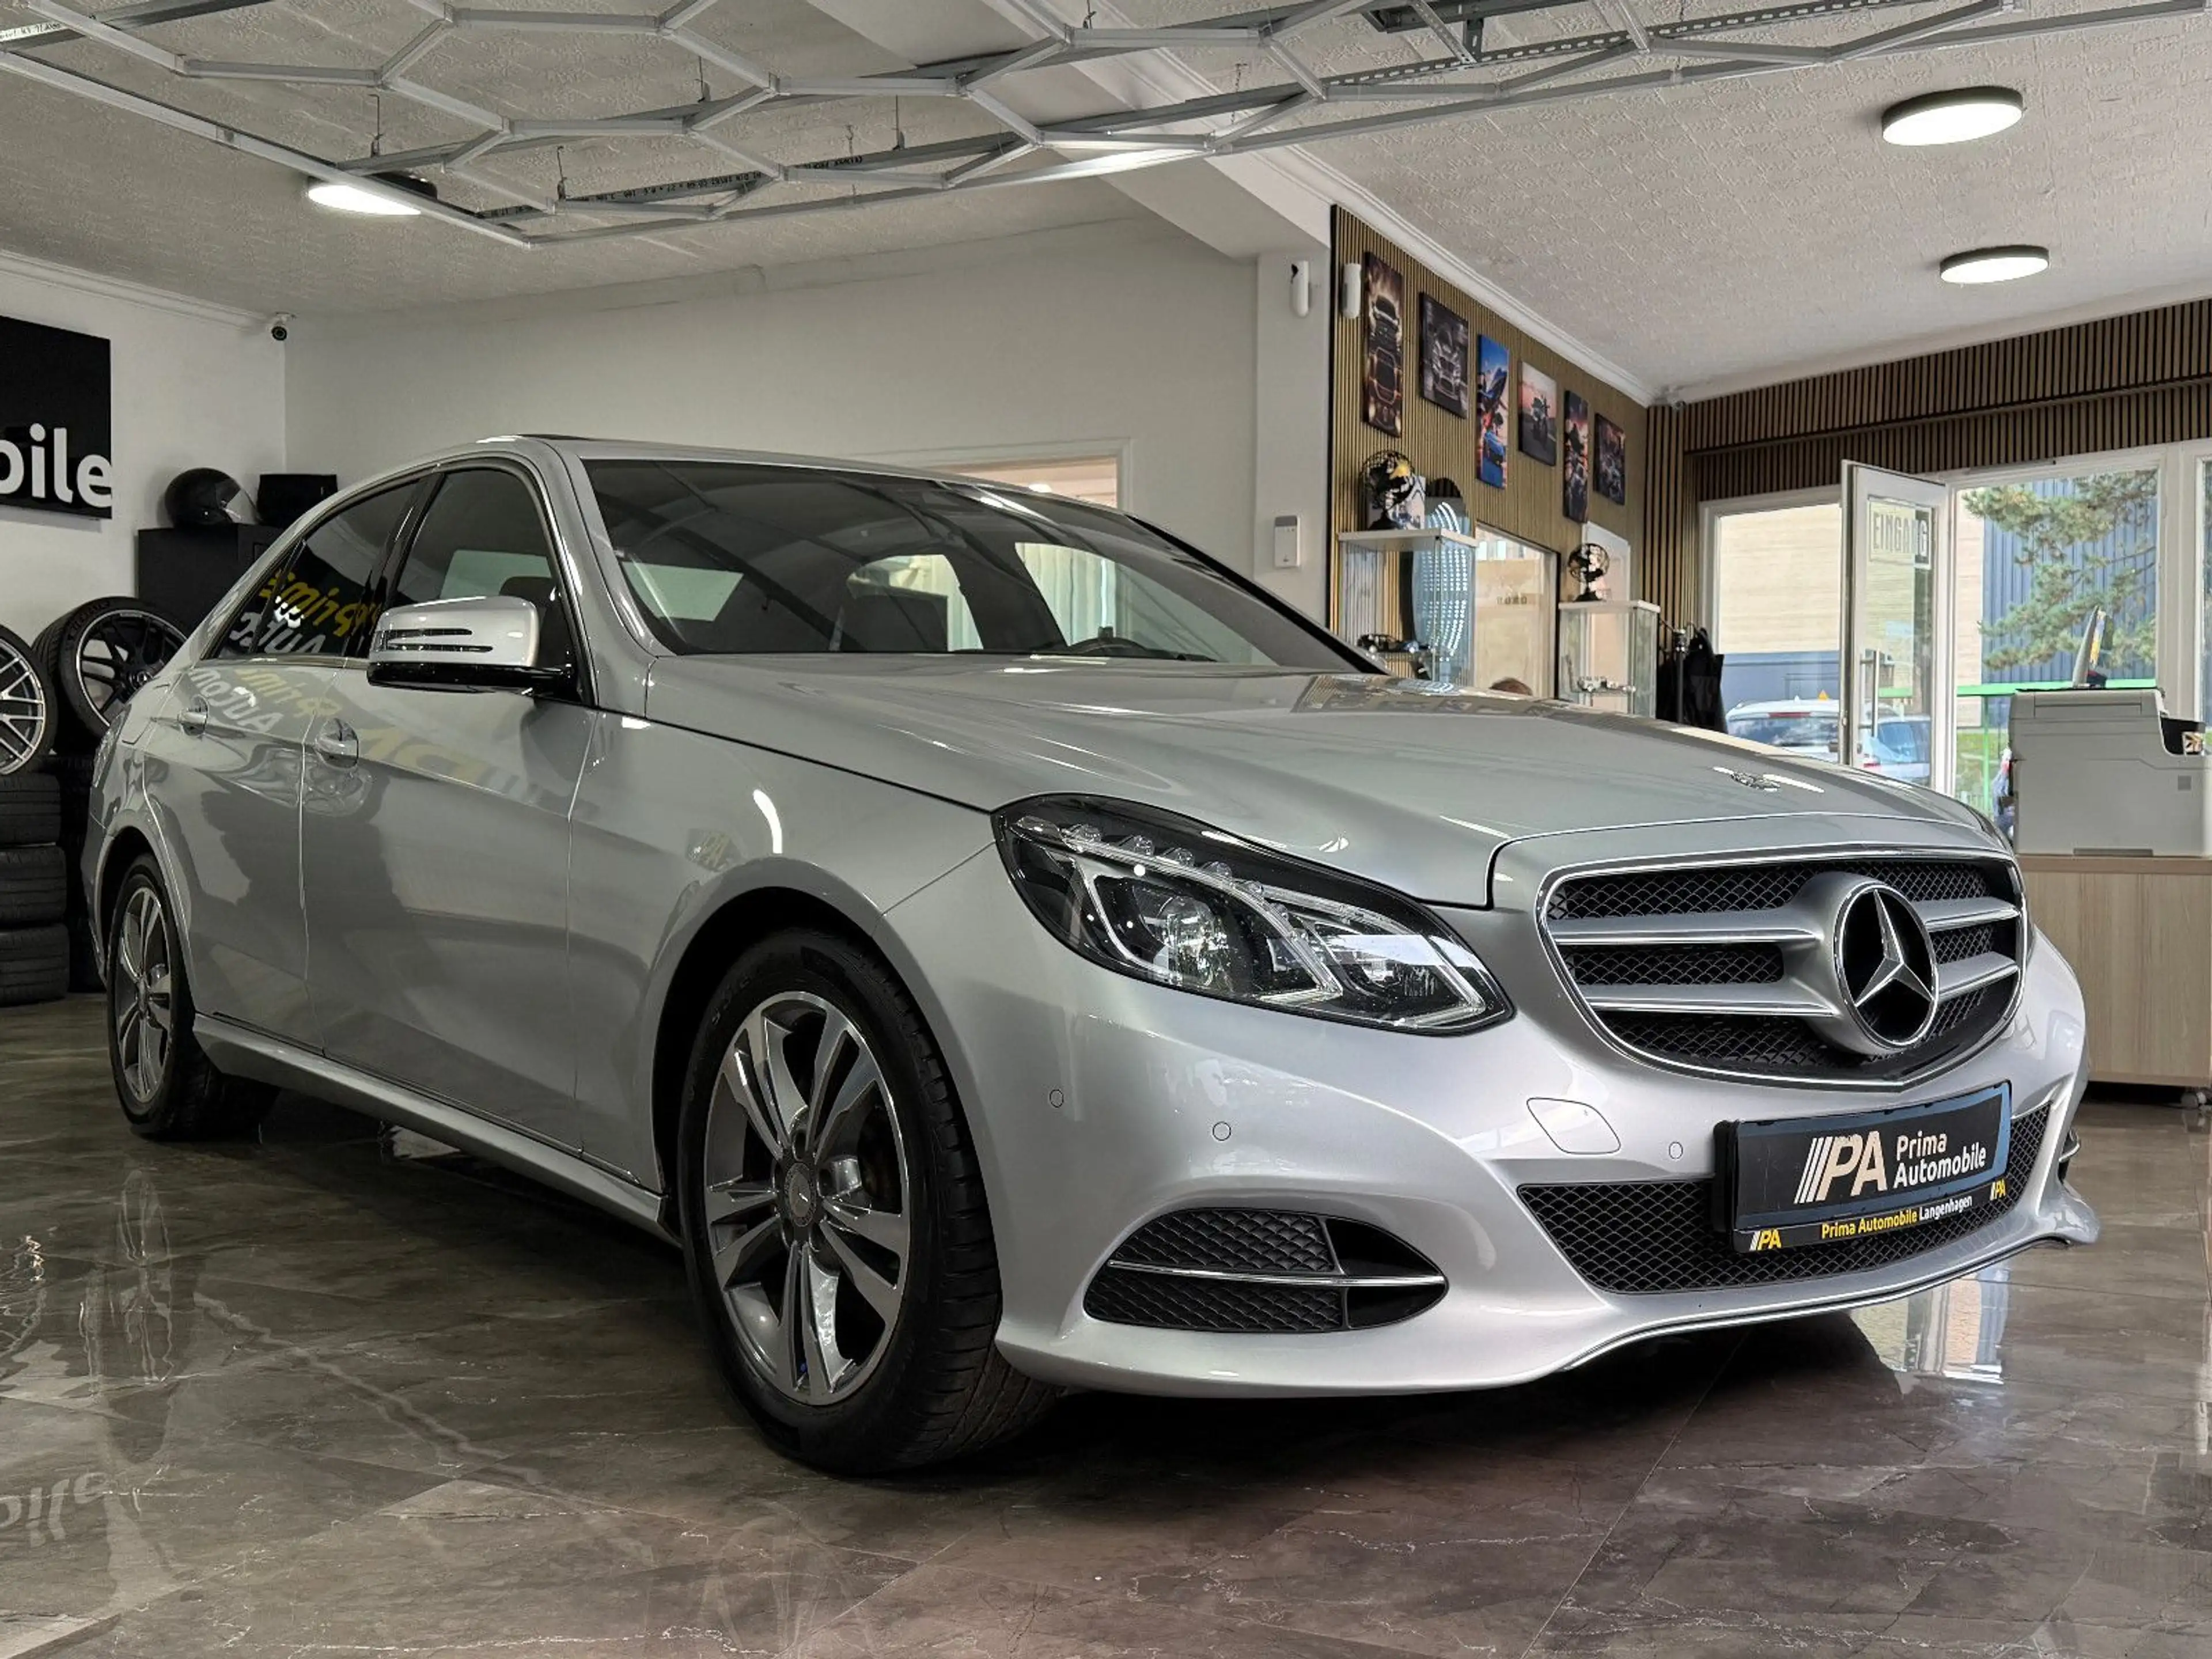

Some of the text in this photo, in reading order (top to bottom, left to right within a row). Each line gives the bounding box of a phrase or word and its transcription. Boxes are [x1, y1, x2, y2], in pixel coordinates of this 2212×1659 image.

[1873, 512, 1928, 557] EINGANG
[1893, 1141, 1987, 1188] Automobile
[1896, 1130, 1948, 1161] Prima
[1821, 1195, 1973, 1239] Prima Automobile Langenhagen
